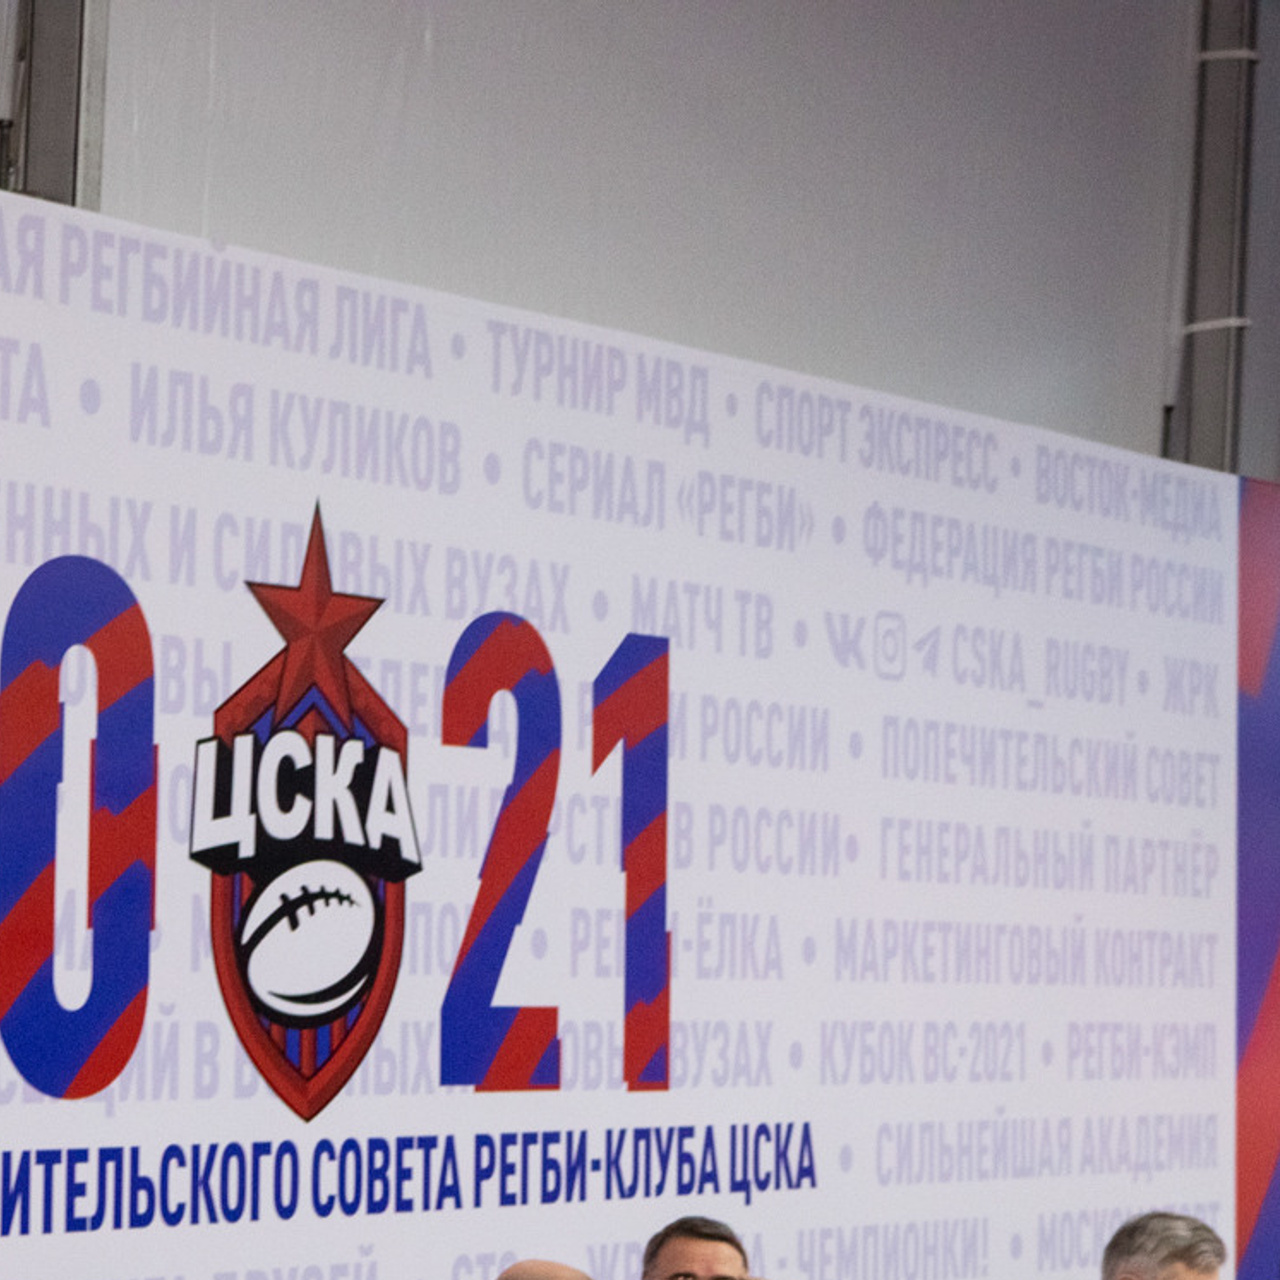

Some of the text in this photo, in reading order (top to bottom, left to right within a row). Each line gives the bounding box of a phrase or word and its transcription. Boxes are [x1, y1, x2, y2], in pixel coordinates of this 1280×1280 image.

[59, 221, 320, 357] РЕГБИЙНАЯ
[329, 284, 433, 380] ЛИГА
[130, 361, 461, 496] ИЛЬЯ КУЛИКОВ
[487, 318, 710, 449] ТУРНИР МВД
[755, 381, 999, 495] СПОРТ ЭКСПРЕСС
[522, 436, 815, 553] СЕРИАЛ «РЕГБИ»
[168, 504, 197, 588] И
[212, 510, 432, 617] СИЛВЫХ
[445, 545, 571, 635] ВУЗАХ
[863, 500, 1226, 627] ФЕДЕРАЦИЯ РЕГБИ РОССИИ
[631, 573, 774, 661] МАТЧ ТВ
[952, 623, 1129, 709] CSKA_RUGBY
[1163, 654, 1220, 719] ЖРК
[699, 692, 829, 773] РОССИИ
[881, 714, 1220, 810] ПОПЕЧИТЕЛЬСКИЙ СОВЕТ
[192, 729, 421, 868] ЦСКА
[674, 801, 693, 870] В
[706, 805, 841, 878] РОССИИ
[440, 611, 670, 1093] 21
[880, 816, 1220, 900] ГЕНЕРАЛЬНЫЙ ПАРТНЁР
[835, 914, 1219, 989] МАРКЕТИНГОВЫЙ КОНТРАКТ
[669, 1019, 773, 1091] ВУЗАХ
[820, 1020, 1027, 1086] КУБОК ВС-2021
[1066, 1021, 1218, 1082] РЕГБИ-КЭМП
[1, 1120, 818, 1237] ИТЕЛЬСКОГО СОВЕТА РЕГБИ-КЛУБА ЦСКА
[876, 1105, 1219, 1186] СИЛЬНЕЙШАЯ АКАДЕМИЯ
